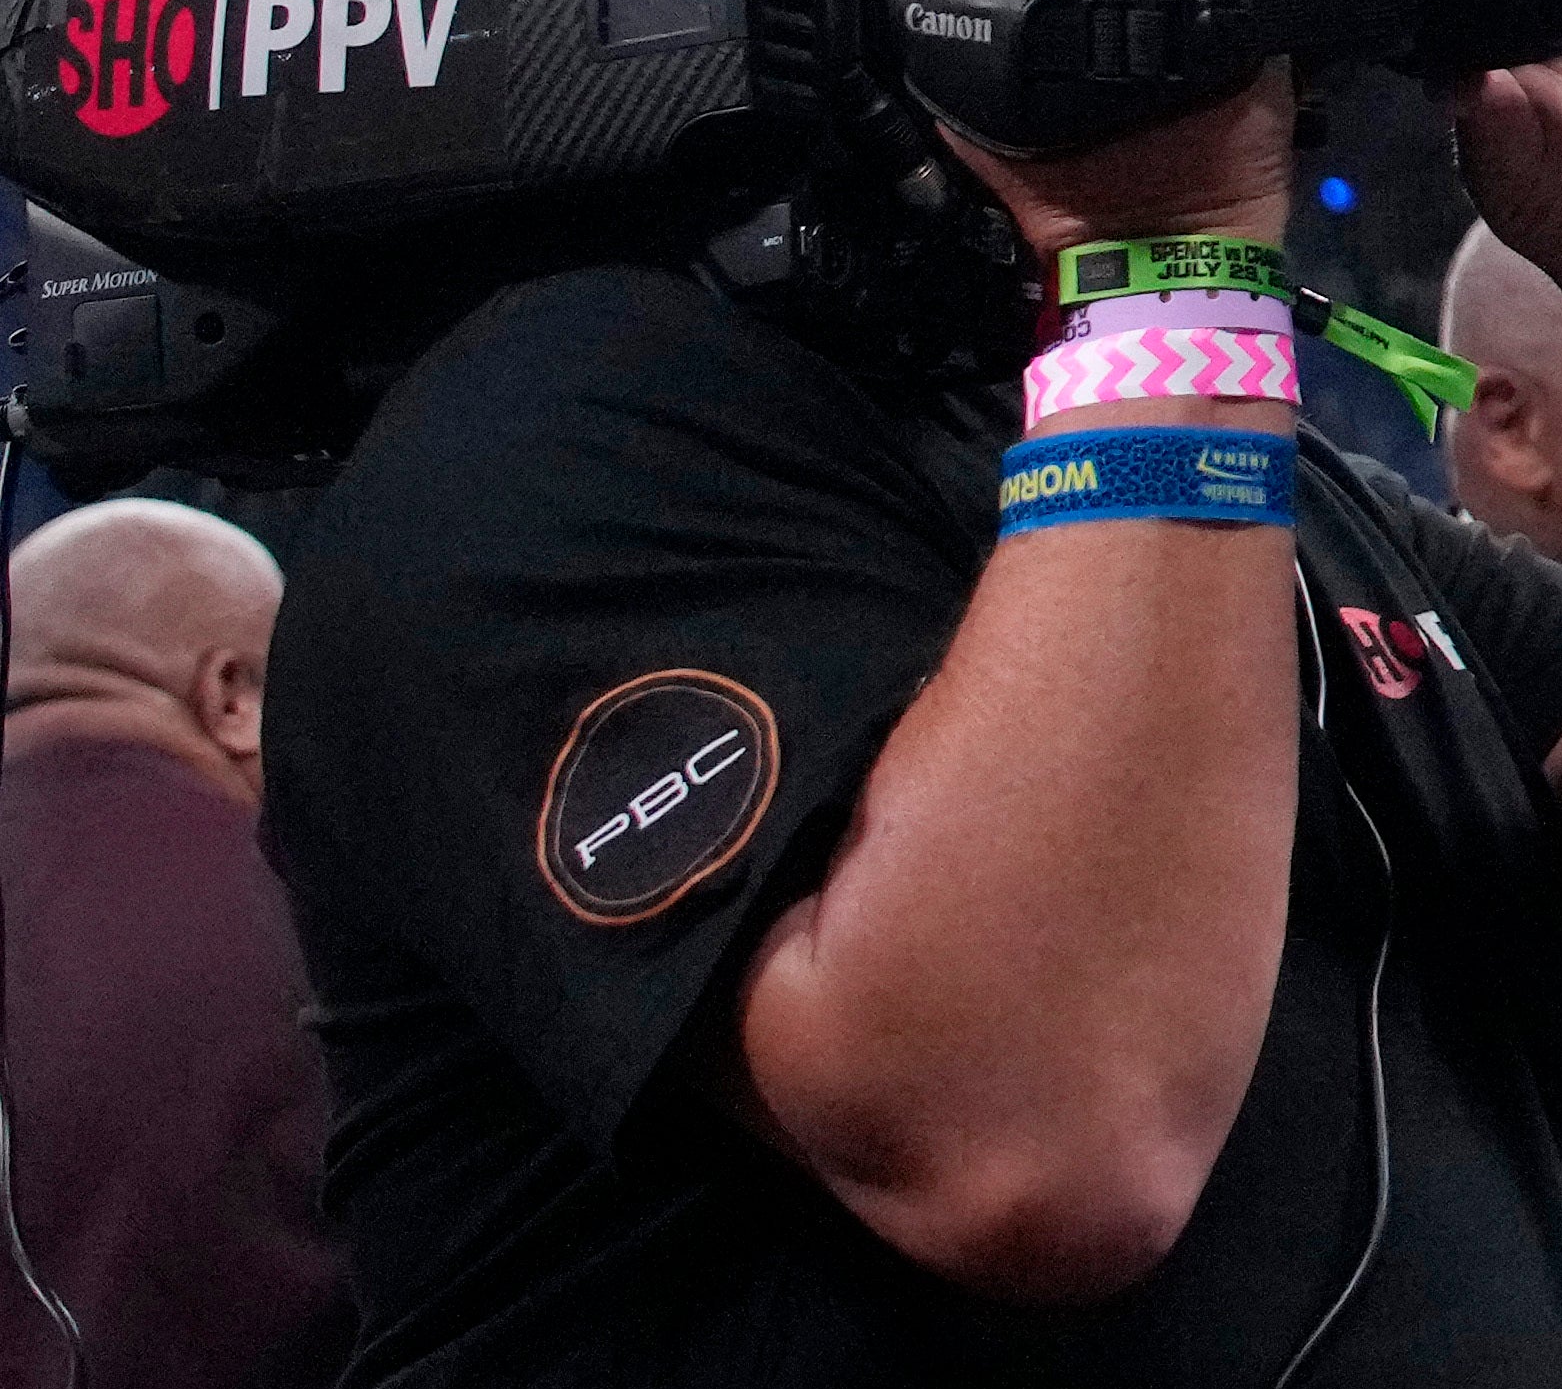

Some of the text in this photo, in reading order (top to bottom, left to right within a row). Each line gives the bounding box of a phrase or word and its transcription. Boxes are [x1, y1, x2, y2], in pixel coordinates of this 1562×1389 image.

[905, 1, 993, 45] Canon
[41, 268, 158, 299] SUPER MOTION
[1156, 261, 1222, 280] JULY
[573, 728, 748, 871] PBC
